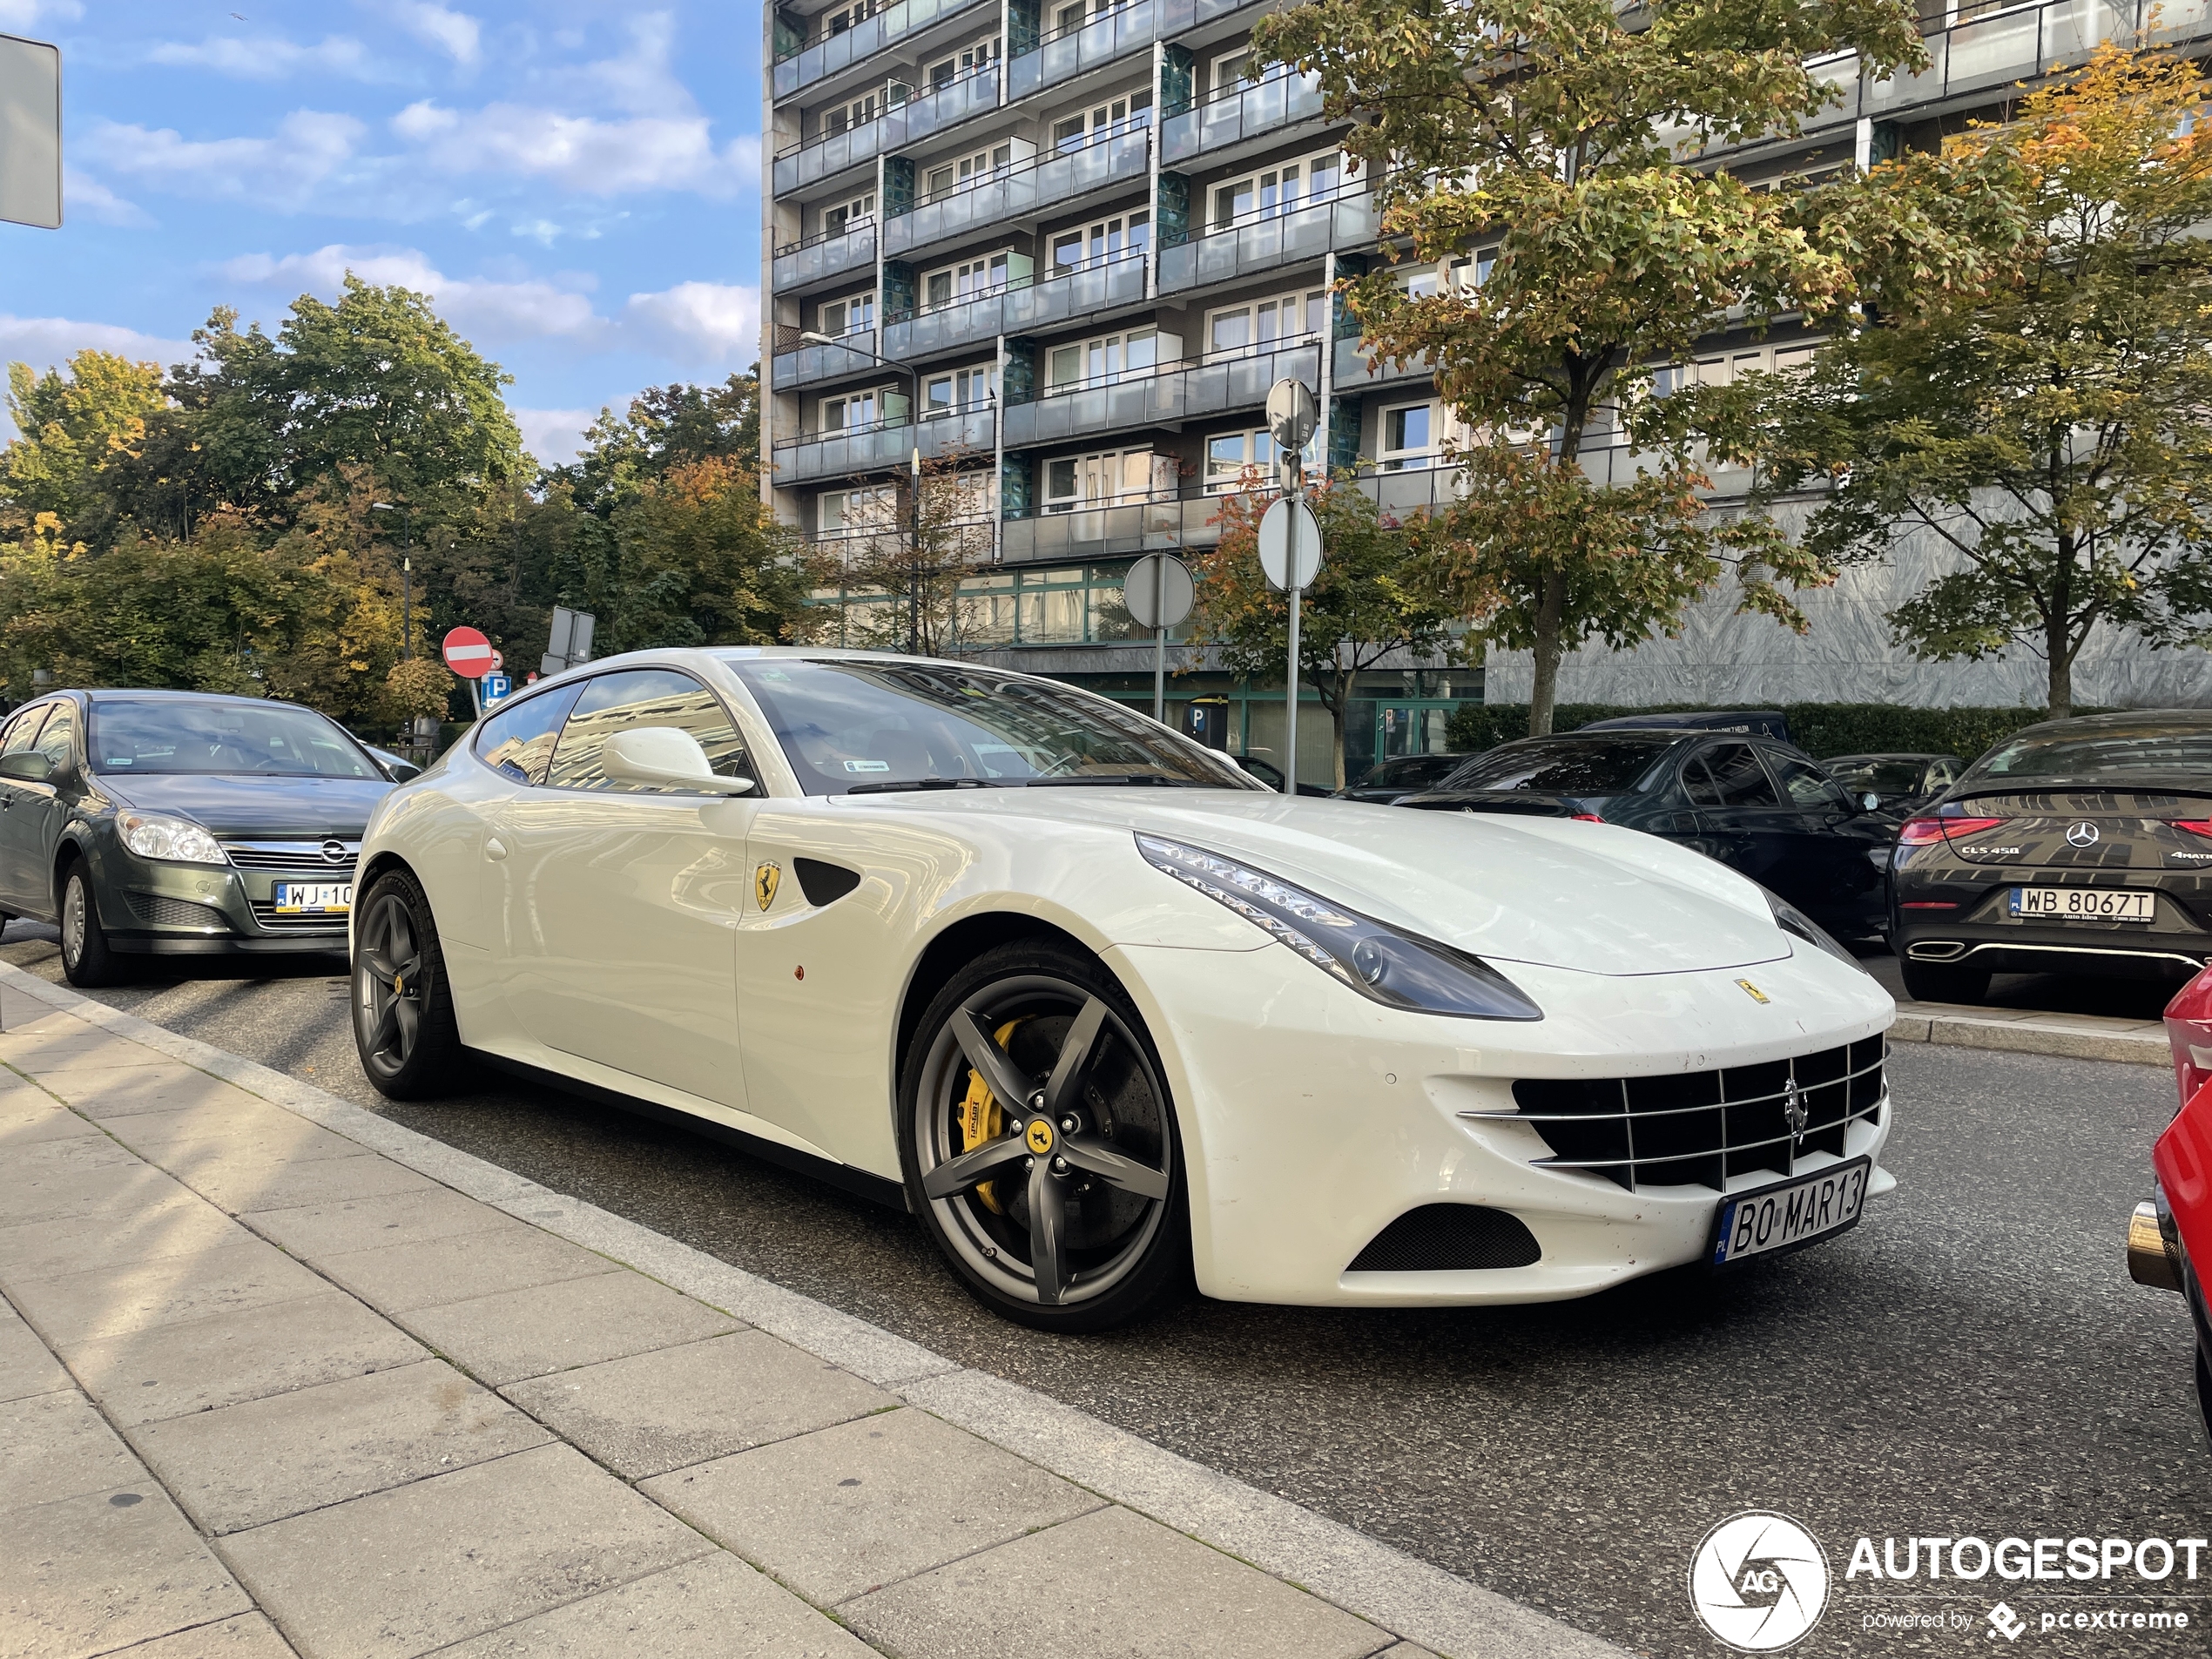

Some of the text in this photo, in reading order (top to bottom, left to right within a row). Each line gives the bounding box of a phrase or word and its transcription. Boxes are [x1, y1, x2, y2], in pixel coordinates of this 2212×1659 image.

[493, 678, 507, 696] P
[1193, 709, 1204, 727] P
[1990, 846, 2020, 855] 450
[291, 887, 319, 905] WJ
[387, 876, 416, 905] MICHELIN
[2027, 890, 2148, 915] WB 8067T
[971, 1101, 980, 1138] Ferrari
[1732, 1170, 1862, 1254] BO MAR13
[1716, 1240, 1726, 1254] PL
